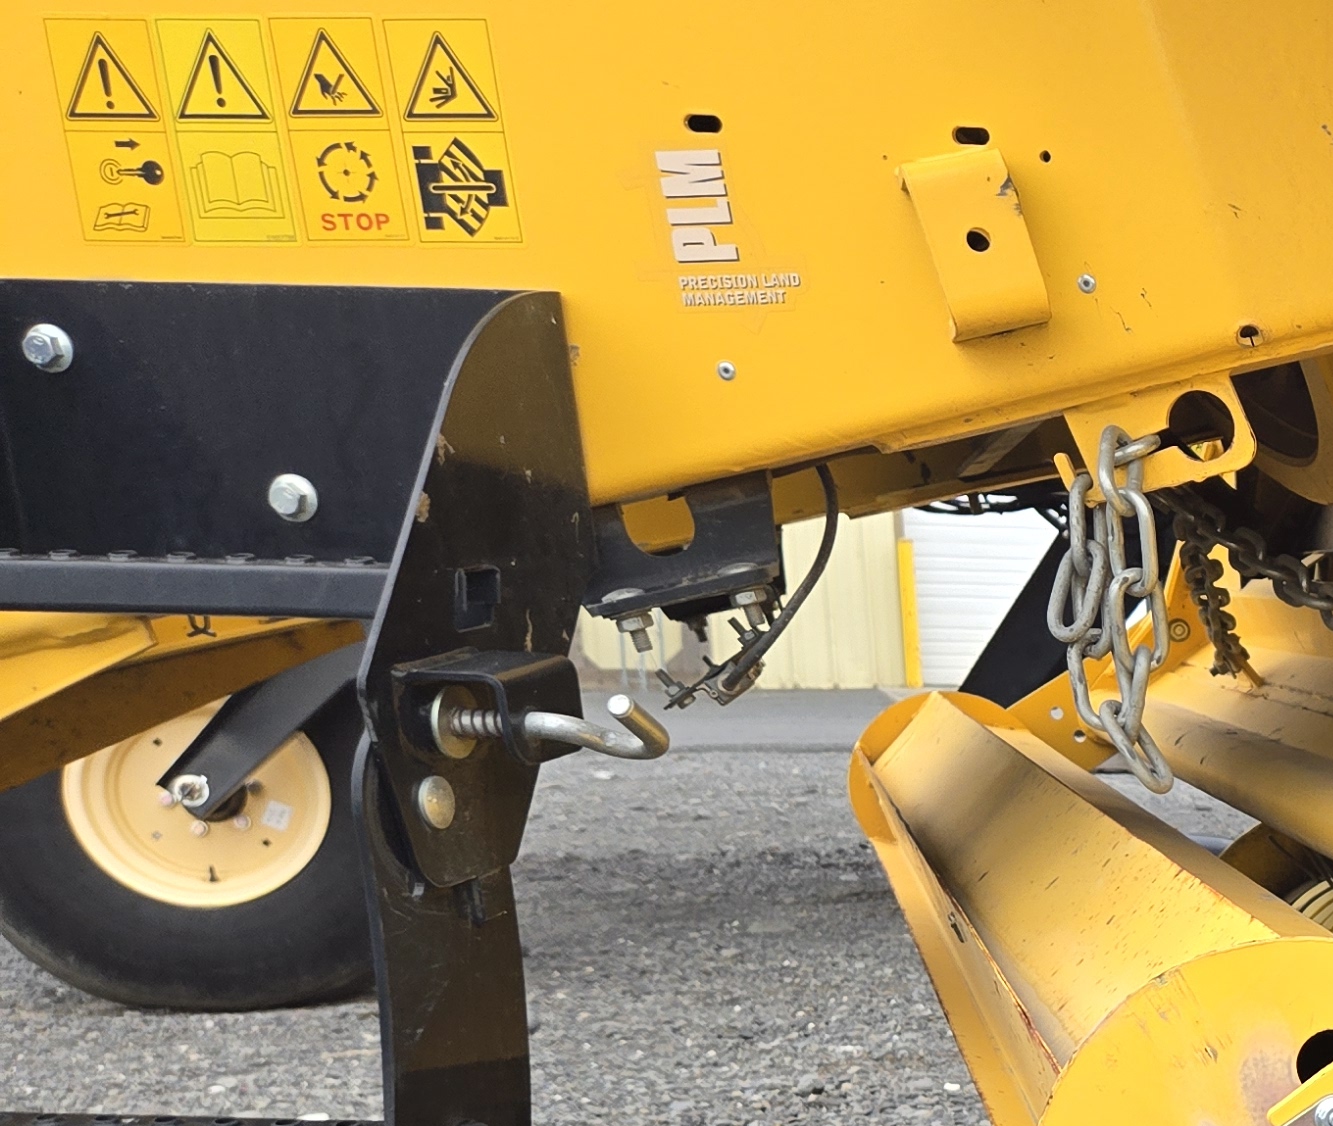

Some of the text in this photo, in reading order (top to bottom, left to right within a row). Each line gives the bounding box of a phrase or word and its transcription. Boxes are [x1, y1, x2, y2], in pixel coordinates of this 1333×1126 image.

[655, 149, 740, 263] PLM
[321, 213, 390, 231] STOP
[679, 272, 801, 290] PRECISION LAND
[682, 291, 787, 307] MANAGEMENT
